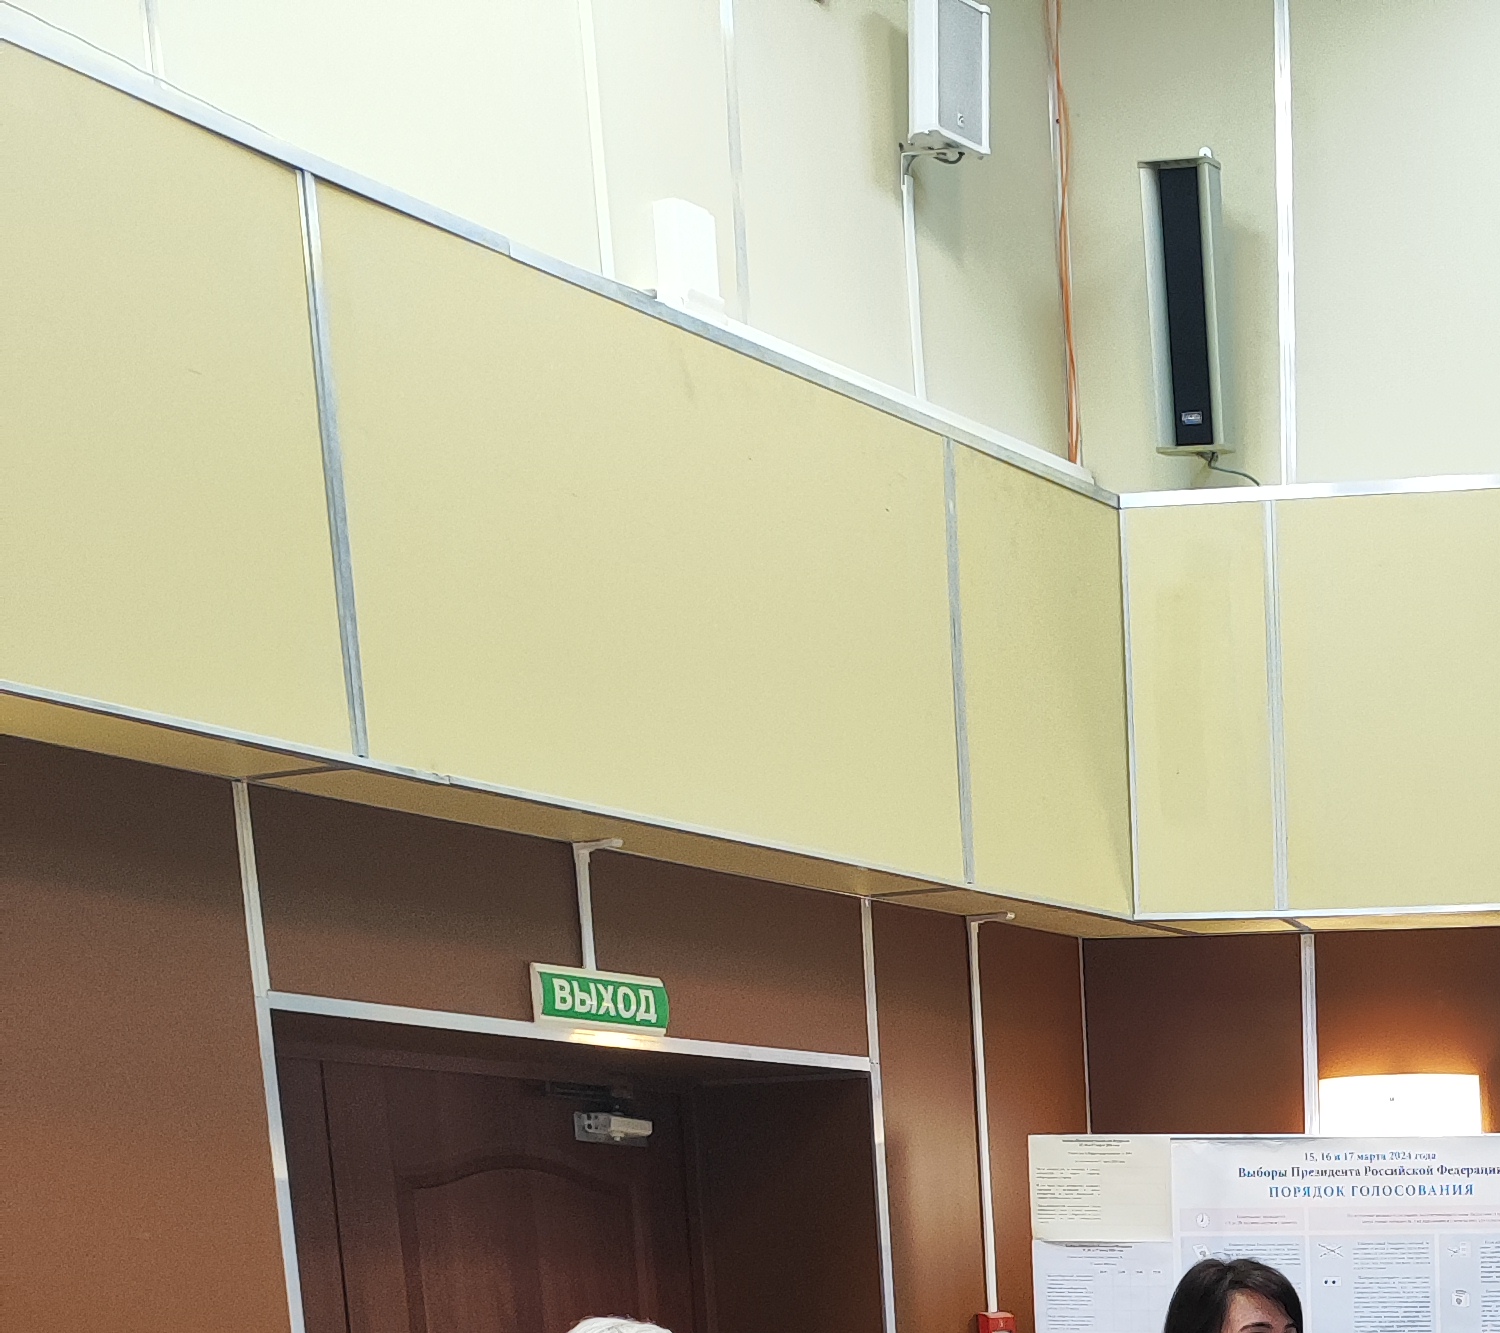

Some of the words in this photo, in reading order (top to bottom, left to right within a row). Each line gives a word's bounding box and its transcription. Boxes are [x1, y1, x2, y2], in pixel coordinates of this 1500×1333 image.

[552, 977, 657, 1023] ВЫХОД
[1304, 1152, 1317, 1162] 15,
[1321, 1152, 1331, 1161] 16
[1344, 1152, 1354, 1160] 17
[1357, 1153, 1386, 1163] марта
[1389, 1151, 1411, 1160] 2024
[1414, 1153, 1436, 1161] года
[1238, 1166, 1287, 1180] Выборы
[1291, 1166, 1360, 1179] Президента
[1364, 1165, 1433, 1176] Российской
[1269, 1186, 1345, 1198] ПОРЯДОК
[1351, 1184, 1473, 1197] ГОЛОСОВАНИЯ
